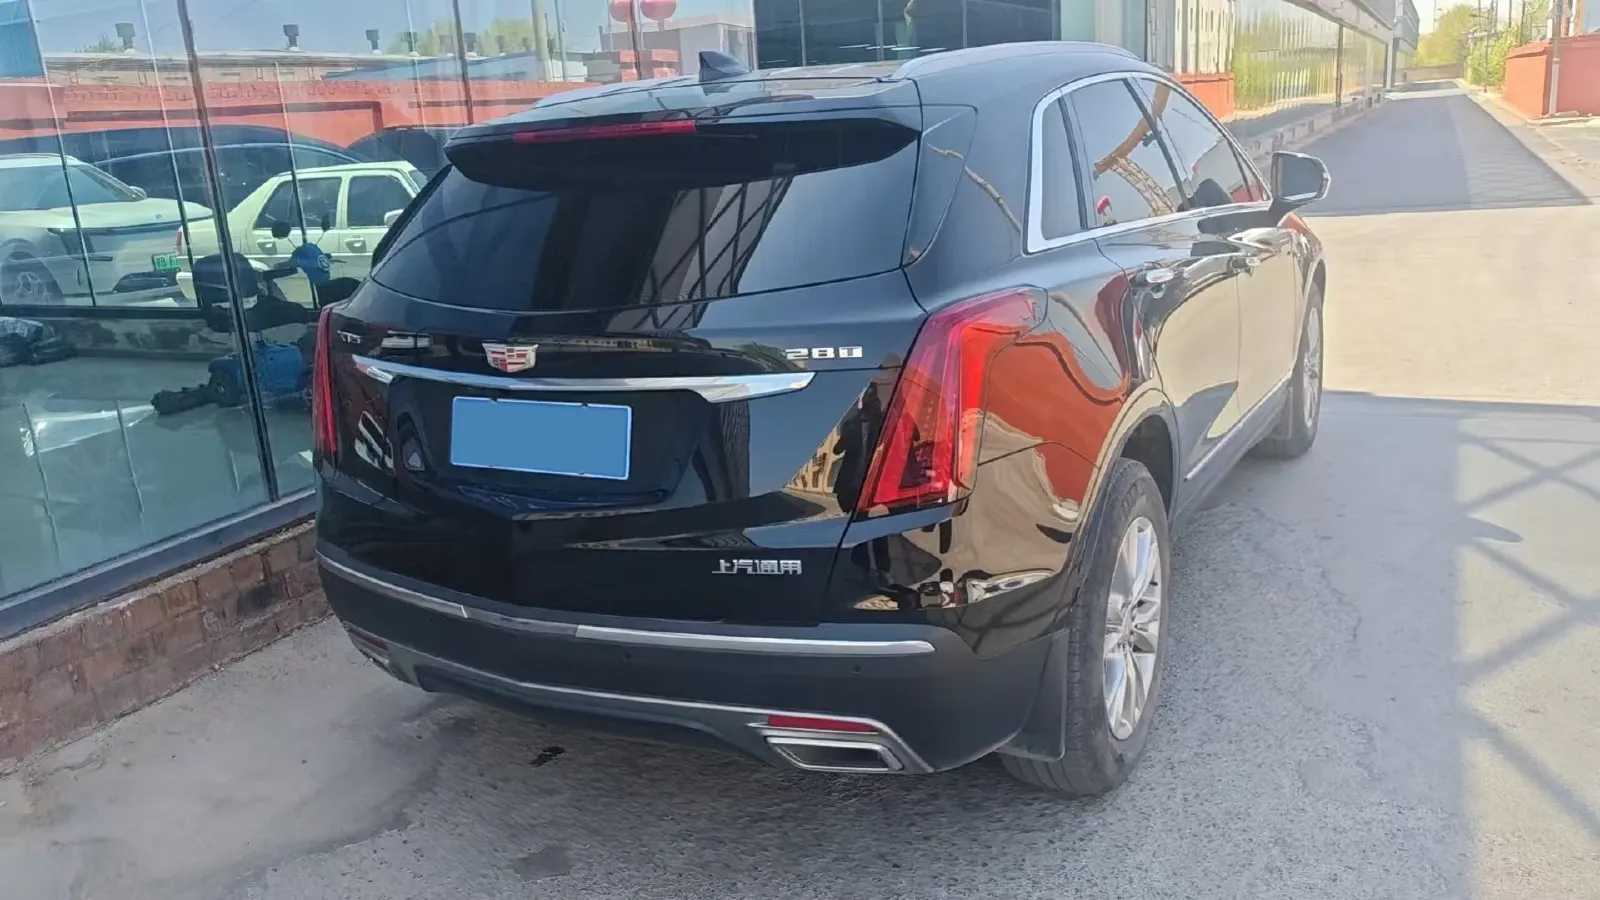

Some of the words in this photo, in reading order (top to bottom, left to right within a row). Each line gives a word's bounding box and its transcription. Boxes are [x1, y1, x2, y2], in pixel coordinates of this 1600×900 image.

[785, 346, 863, 361] 28T
[711, 559, 802, 575] 上汽通用
